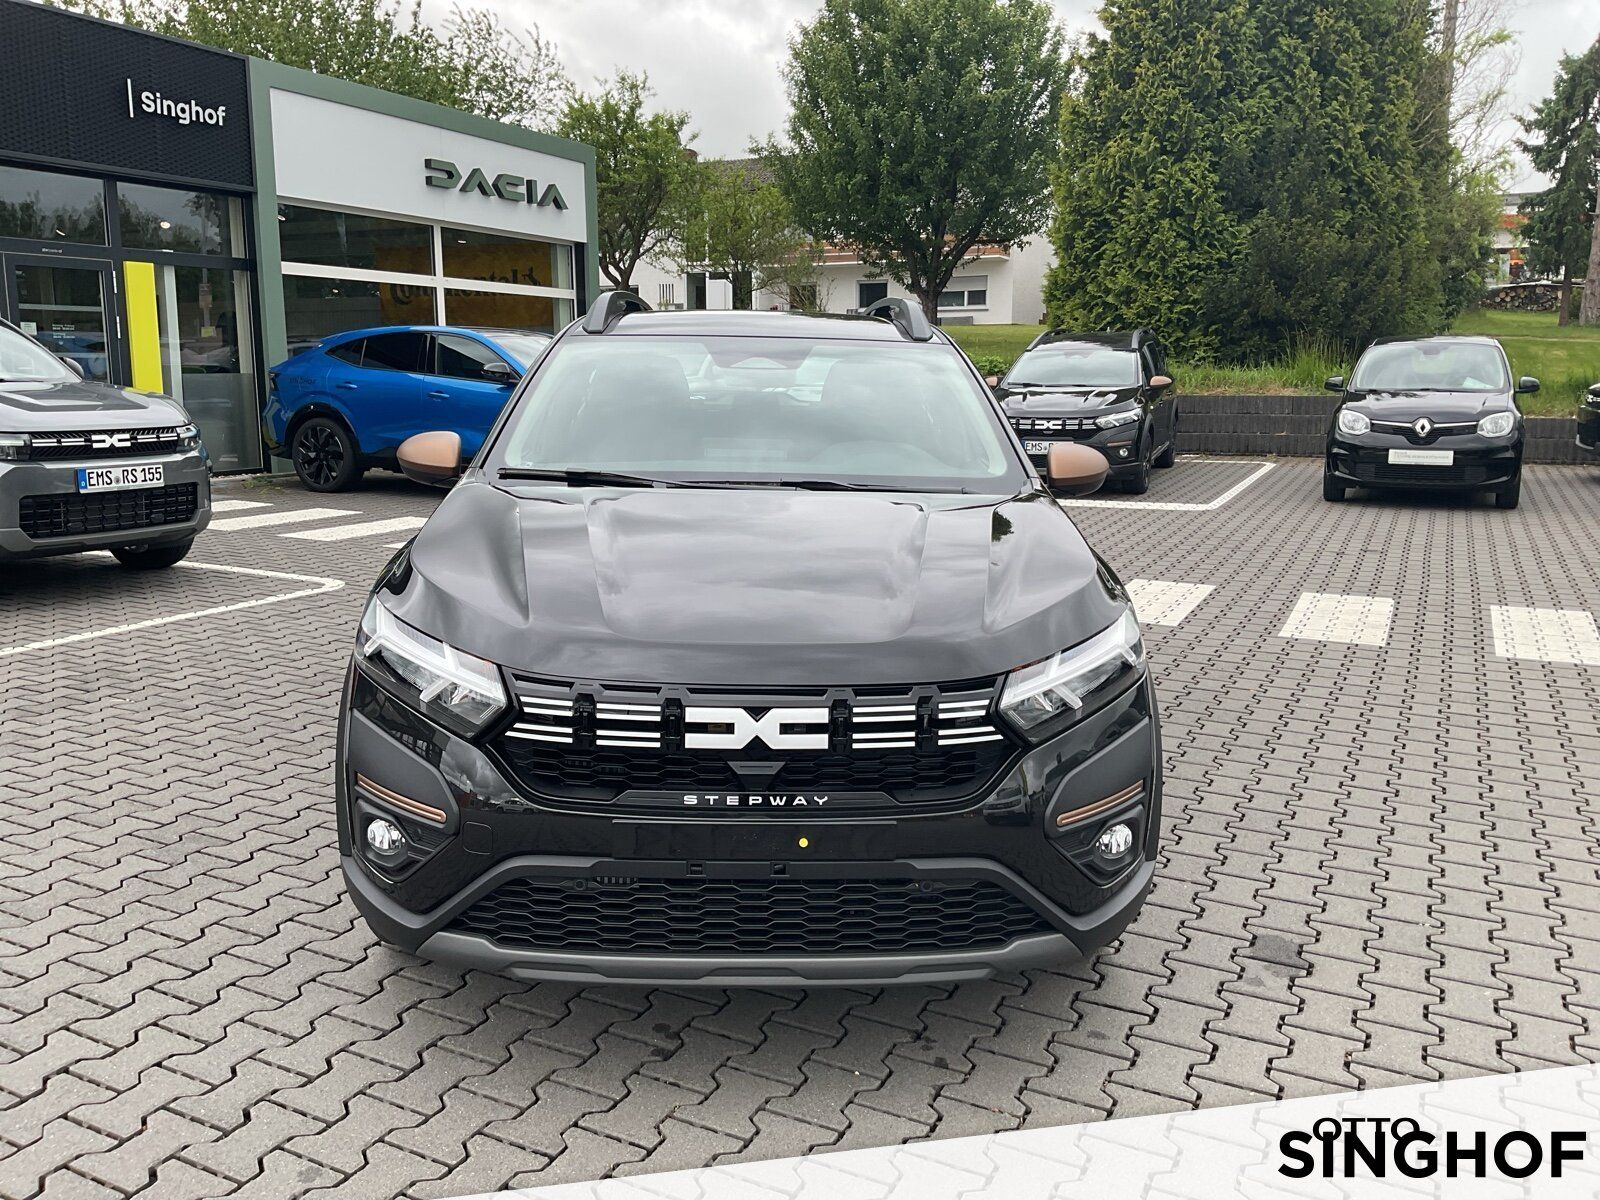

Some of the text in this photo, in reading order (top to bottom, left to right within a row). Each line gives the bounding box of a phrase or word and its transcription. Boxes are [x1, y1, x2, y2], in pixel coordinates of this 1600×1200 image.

[141, 91, 226, 126] Singhof
[424, 158, 569, 210] DACIA
[1025, 442, 1043, 451] EMS
[87, 470, 113, 487] EMS
[122, 468, 138, 484] RS
[140, 466, 162, 483] 155
[683, 794, 829, 806] STEPWAY
